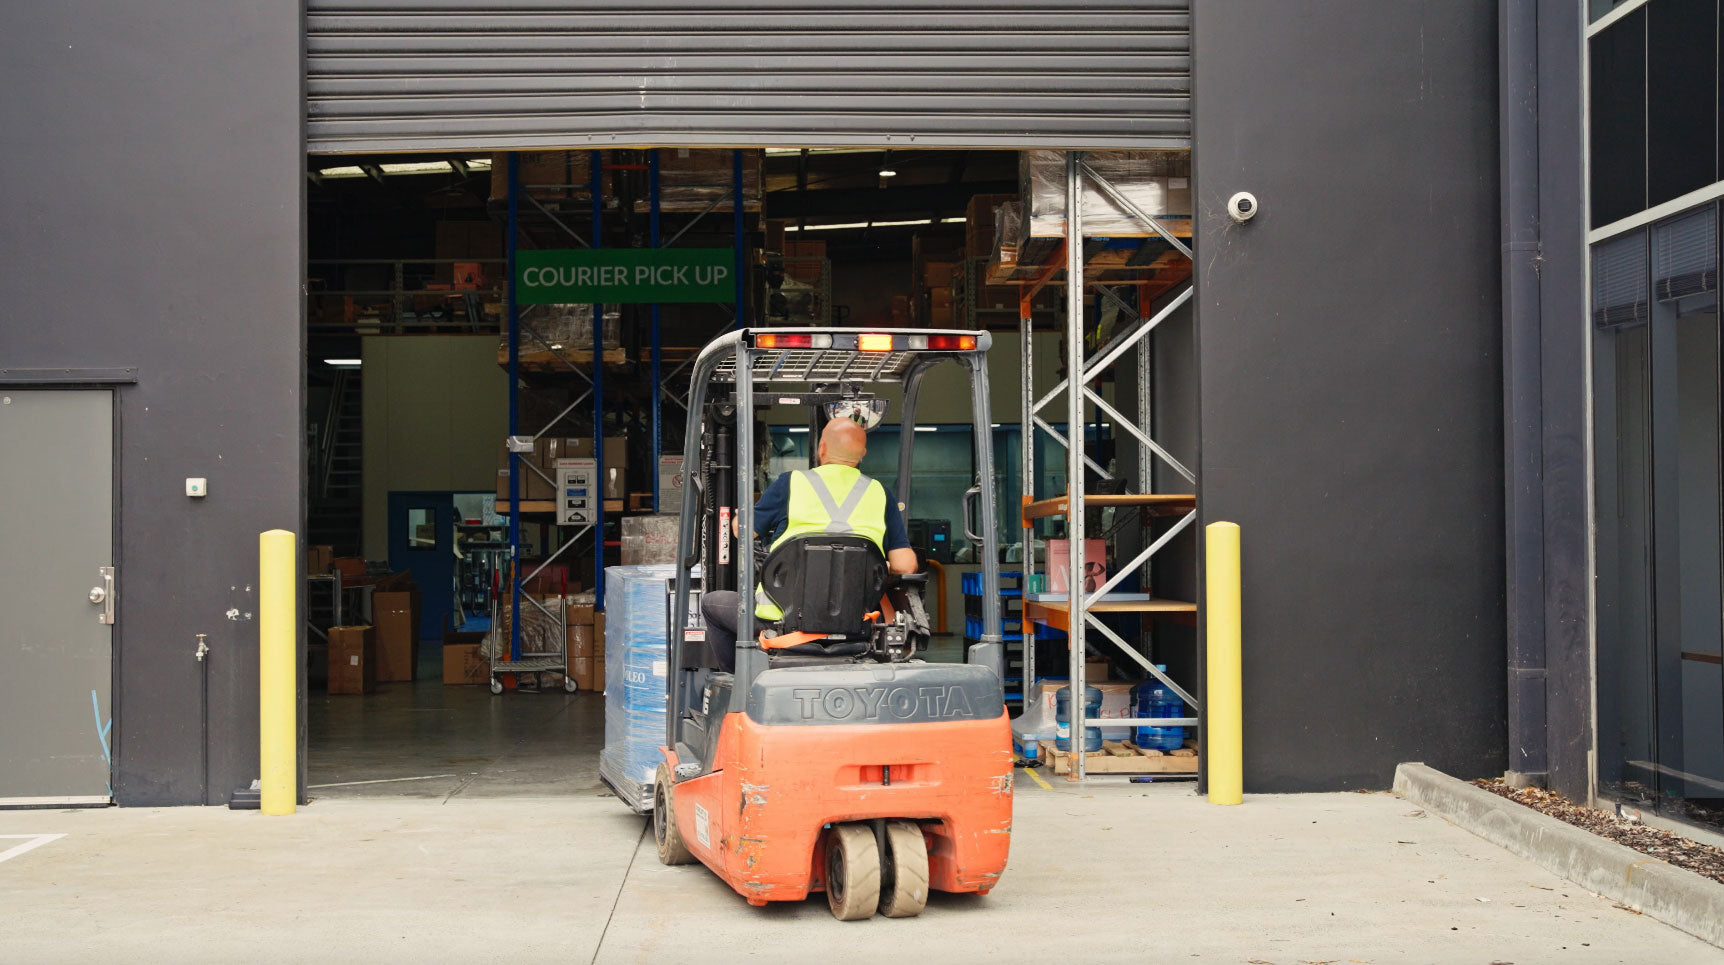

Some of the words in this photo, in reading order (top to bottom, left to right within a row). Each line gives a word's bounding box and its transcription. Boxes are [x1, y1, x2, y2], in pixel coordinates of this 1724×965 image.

[523, 266, 630, 287] COURIER
[635, 265, 690, 286] PICK
[695, 265, 728, 286] UP
[793, 685, 974, 720] TOYOTA
